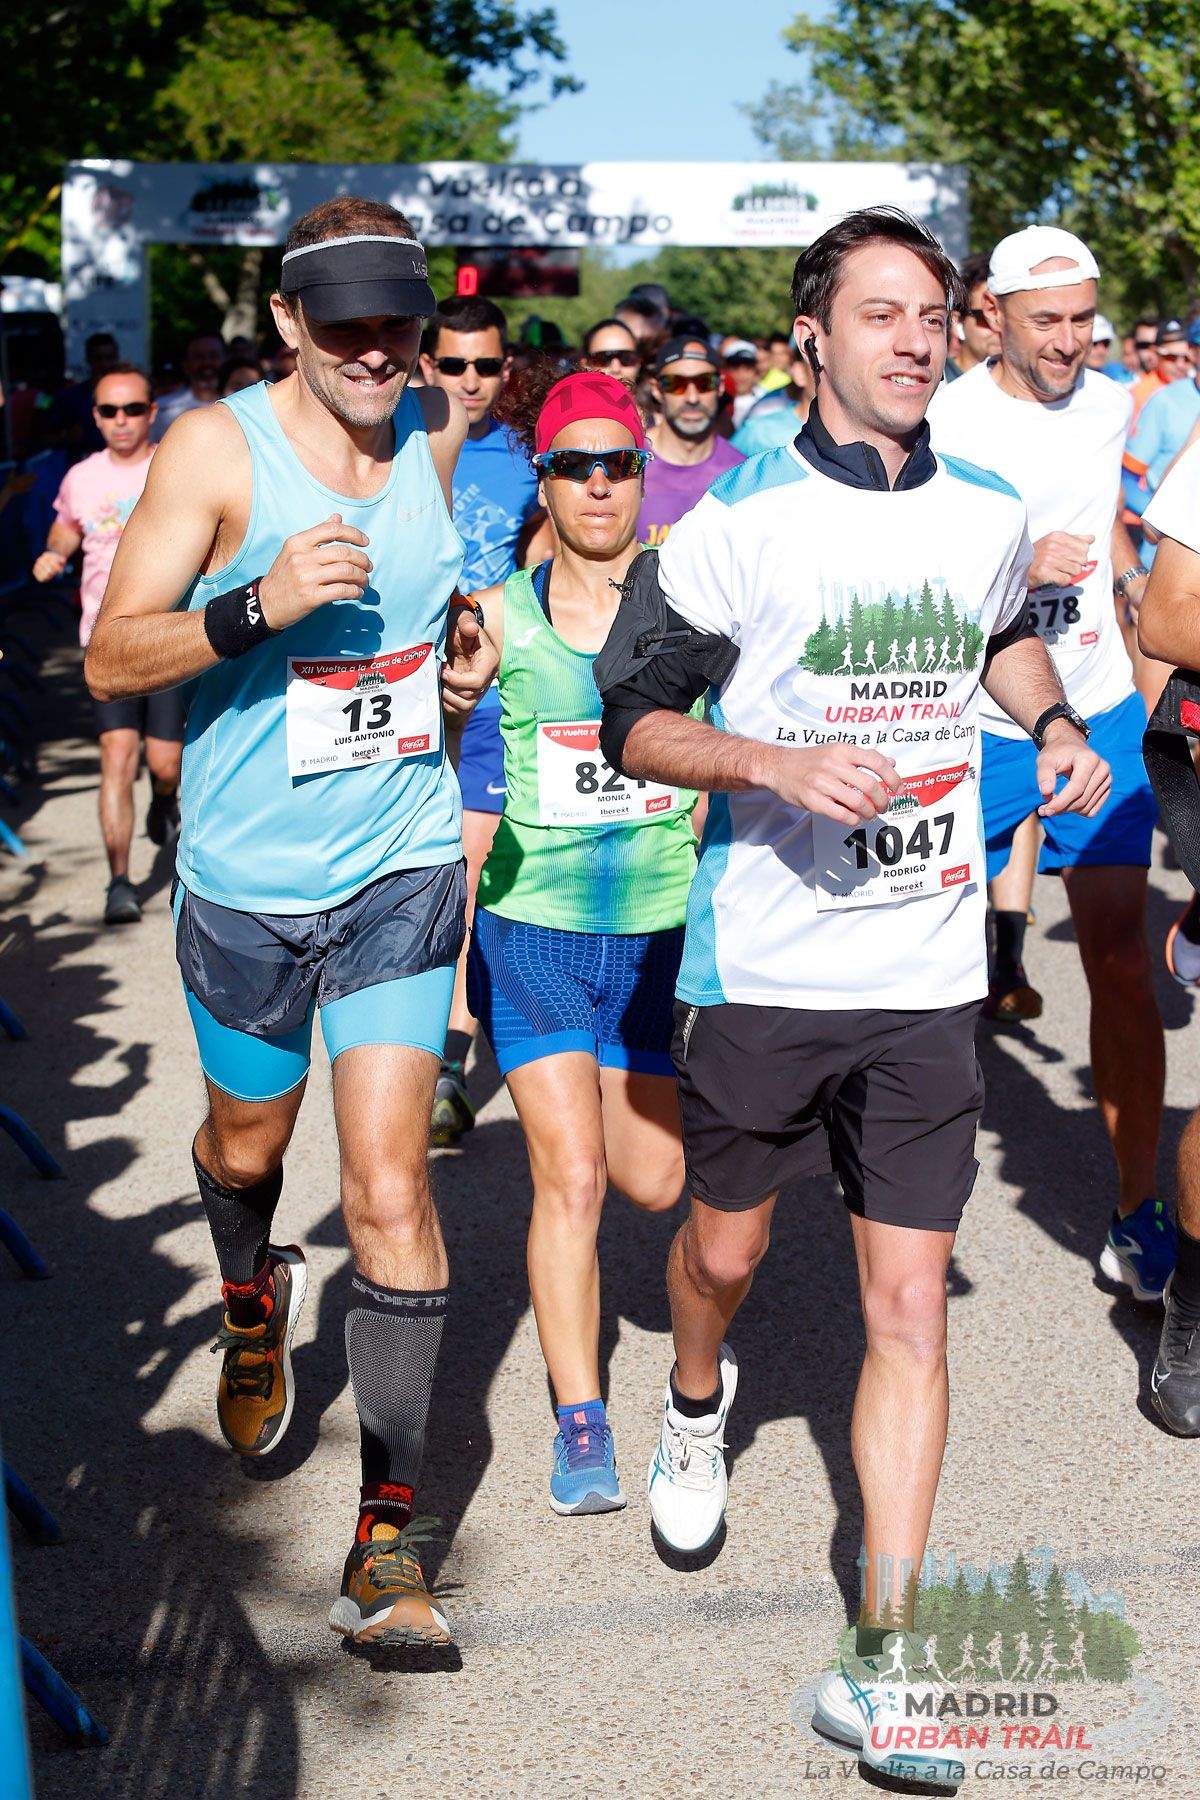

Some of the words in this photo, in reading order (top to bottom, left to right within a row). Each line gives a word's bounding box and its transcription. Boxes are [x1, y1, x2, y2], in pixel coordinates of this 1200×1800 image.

[558, 176, 585, 198] a
[407, 213, 469, 234] asa
[482, 206, 527, 236] de
[542, 207, 673, 242] Campo
[245, 583, 261, 626] FILA
[301, 666, 314, 674] XII
[316, 664, 347, 674] Vuelta
[370, 659, 390, 670] Casa
[391, 656, 403, 665] de
[403, 649, 427, 662] Campo
[850, 680, 948, 700] MADRID
[342, 694, 392, 733] 13
[825, 705, 905, 724] URBAN
[910, 702, 962, 721] TRAIL
[334, 736, 353, 746] LUIS
[354, 729, 395, 743] ANTONIO
[562, 728, 589, 737] Vuelta
[776, 727, 796, 742] La
[803, 729, 857, 745] Vuelta
[861, 735, 871, 745] a
[876, 730, 887, 744] la
[892, 728, 930, 743] Casa
[934, 727, 951, 741] de
[309, 756, 338, 766] MADRID
[575, 761, 646, 795] 82
[924, 777, 935, 786] de
[936, 771, 964, 783] Campo
[597, 793, 631, 803] MONICA
[843, 812, 955, 870] 1047
[883, 864, 927, 878] RODRIGO
[841, 889, 874, 899] MADRID
